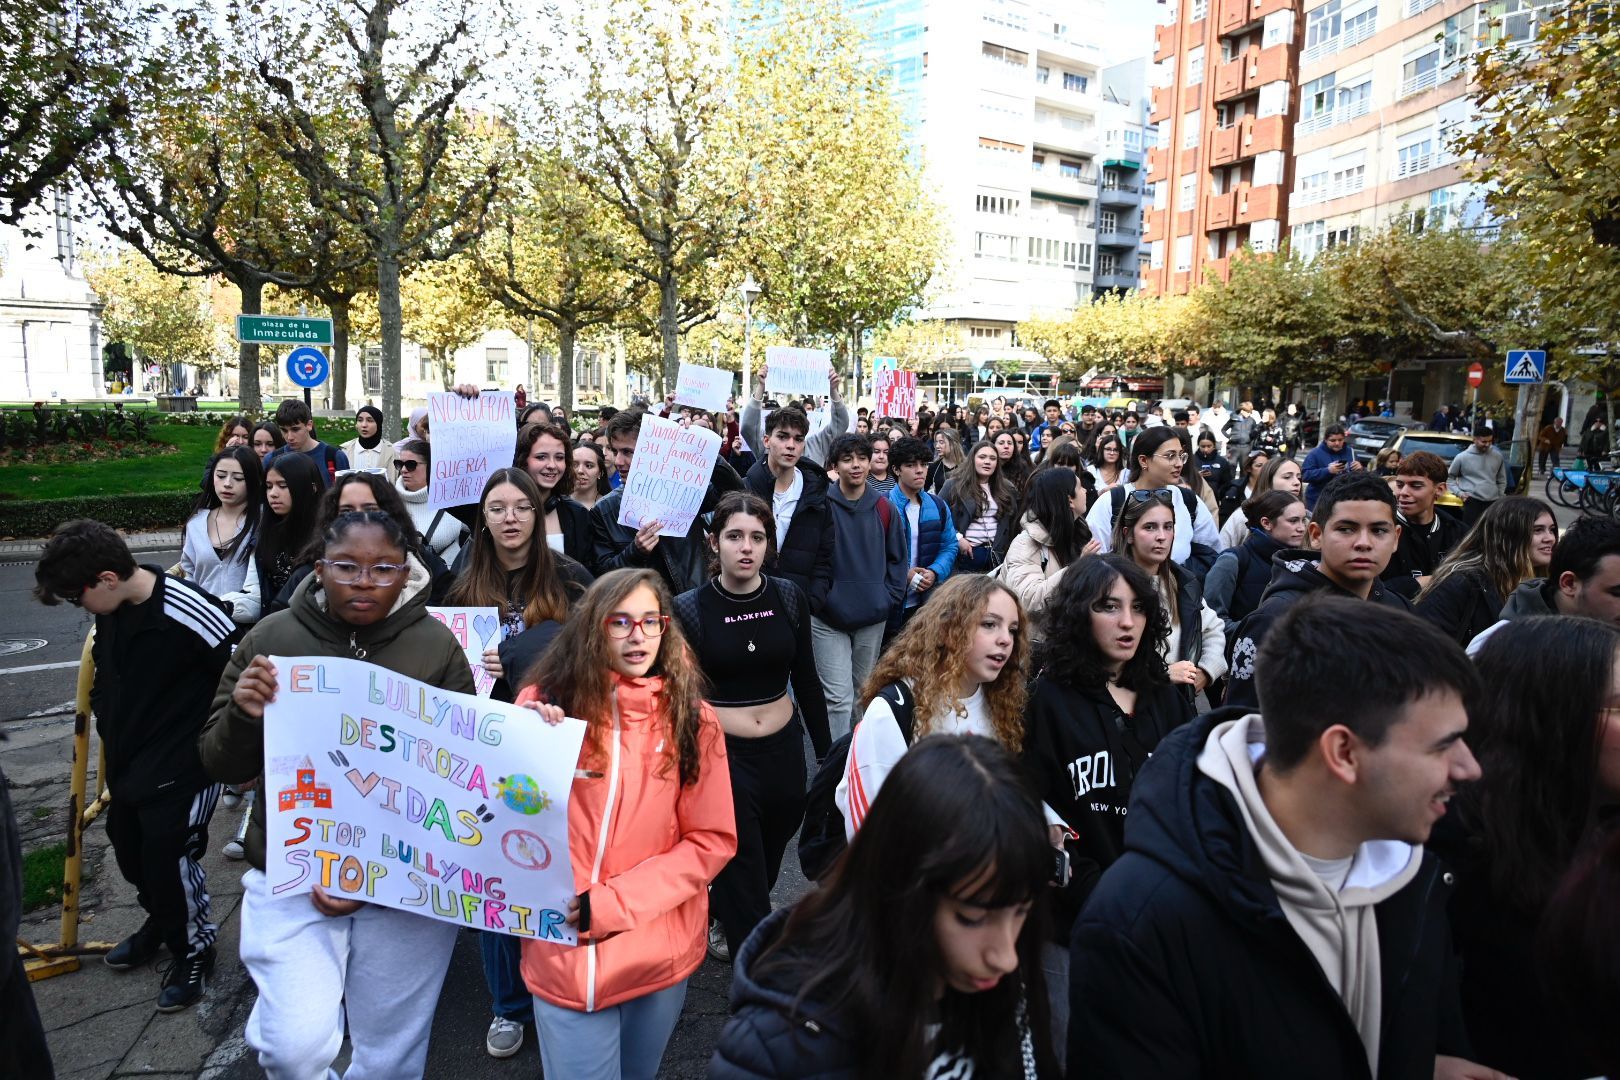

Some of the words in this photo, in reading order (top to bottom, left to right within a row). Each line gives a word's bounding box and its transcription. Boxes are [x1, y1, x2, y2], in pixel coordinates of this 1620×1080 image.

[253, 328, 318, 339] Inmaculada
[431, 394, 457, 423] NO
[636, 457, 706, 487] FUERON
[291, 664, 340, 693] EL
[340, 713, 489, 799] DESTROZA
[1090, 802, 1110, 812] NEW
[284, 817, 366, 848] STOP
[273, 849, 388, 897] STOP
